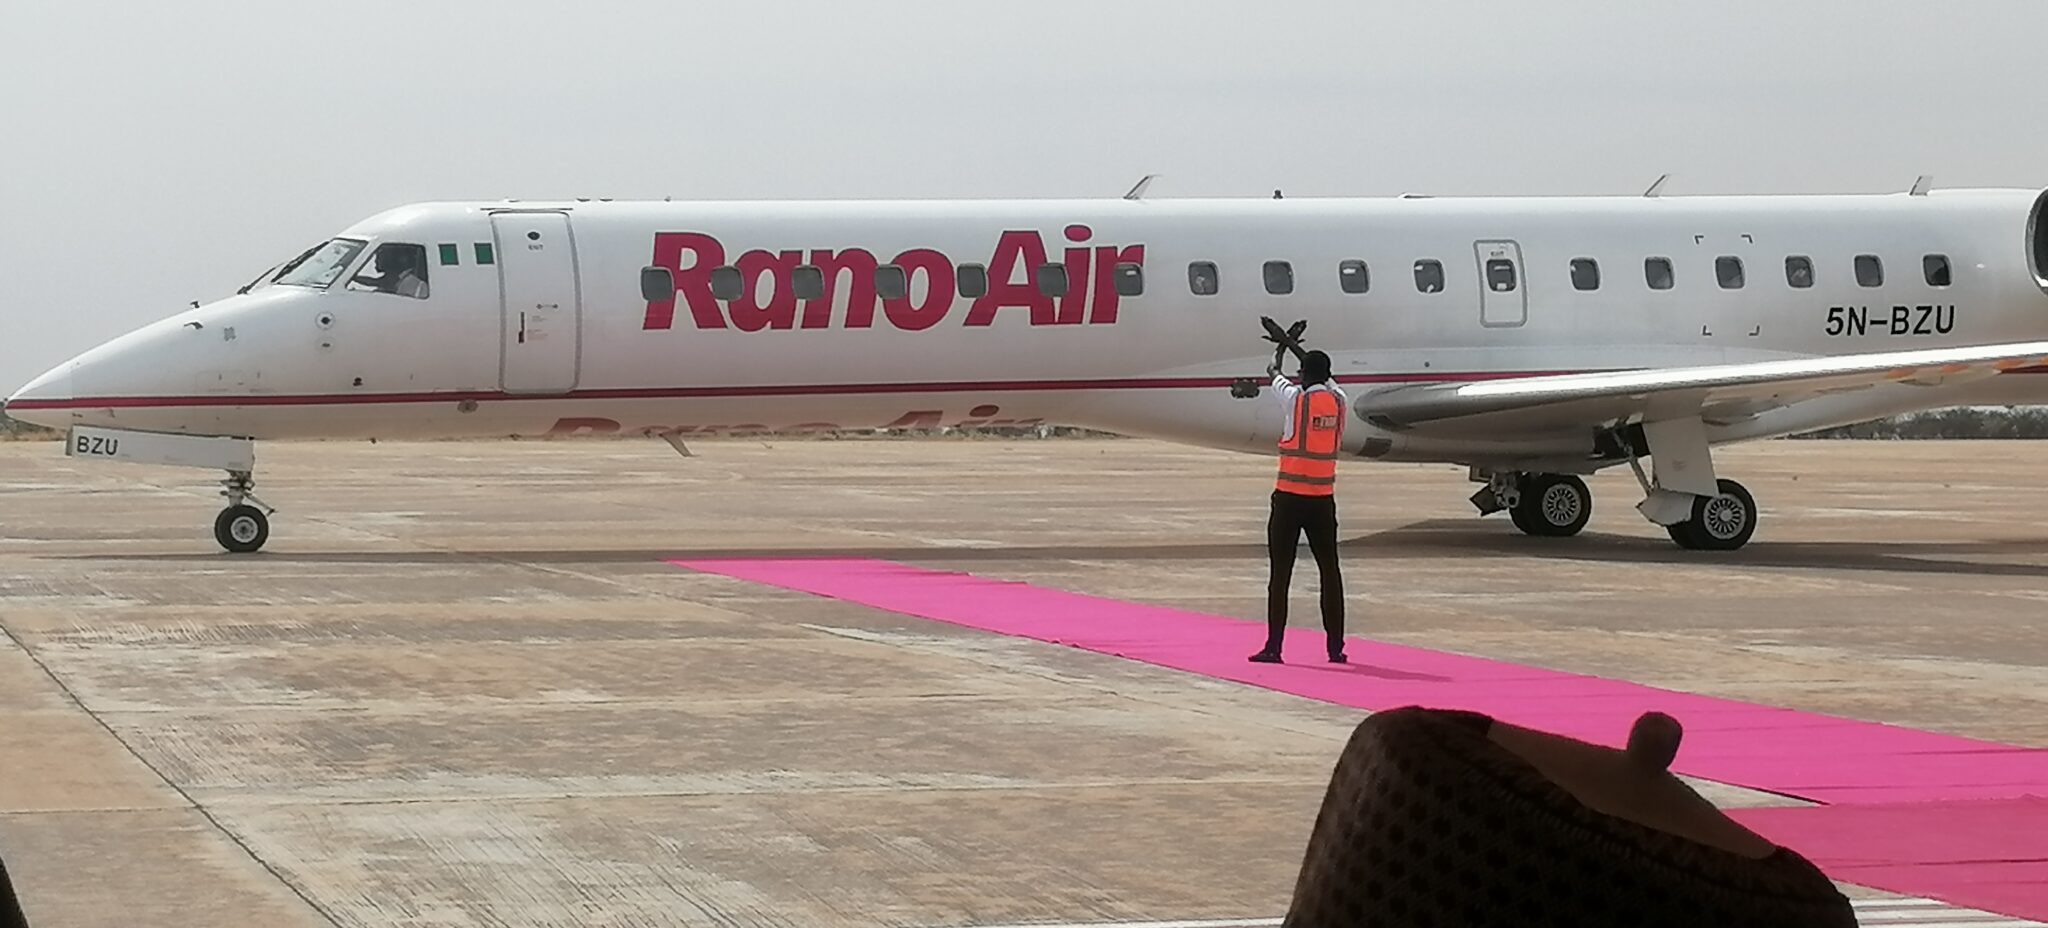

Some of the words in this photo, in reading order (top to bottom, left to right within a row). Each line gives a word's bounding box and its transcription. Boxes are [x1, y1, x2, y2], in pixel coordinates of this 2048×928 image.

[643, 232, 955, 332] Rano
[963, 224, 1145, 326] Air
[1825, 305, 1955, 336] 5N-BZU
[76, 436, 118, 455] BZU
